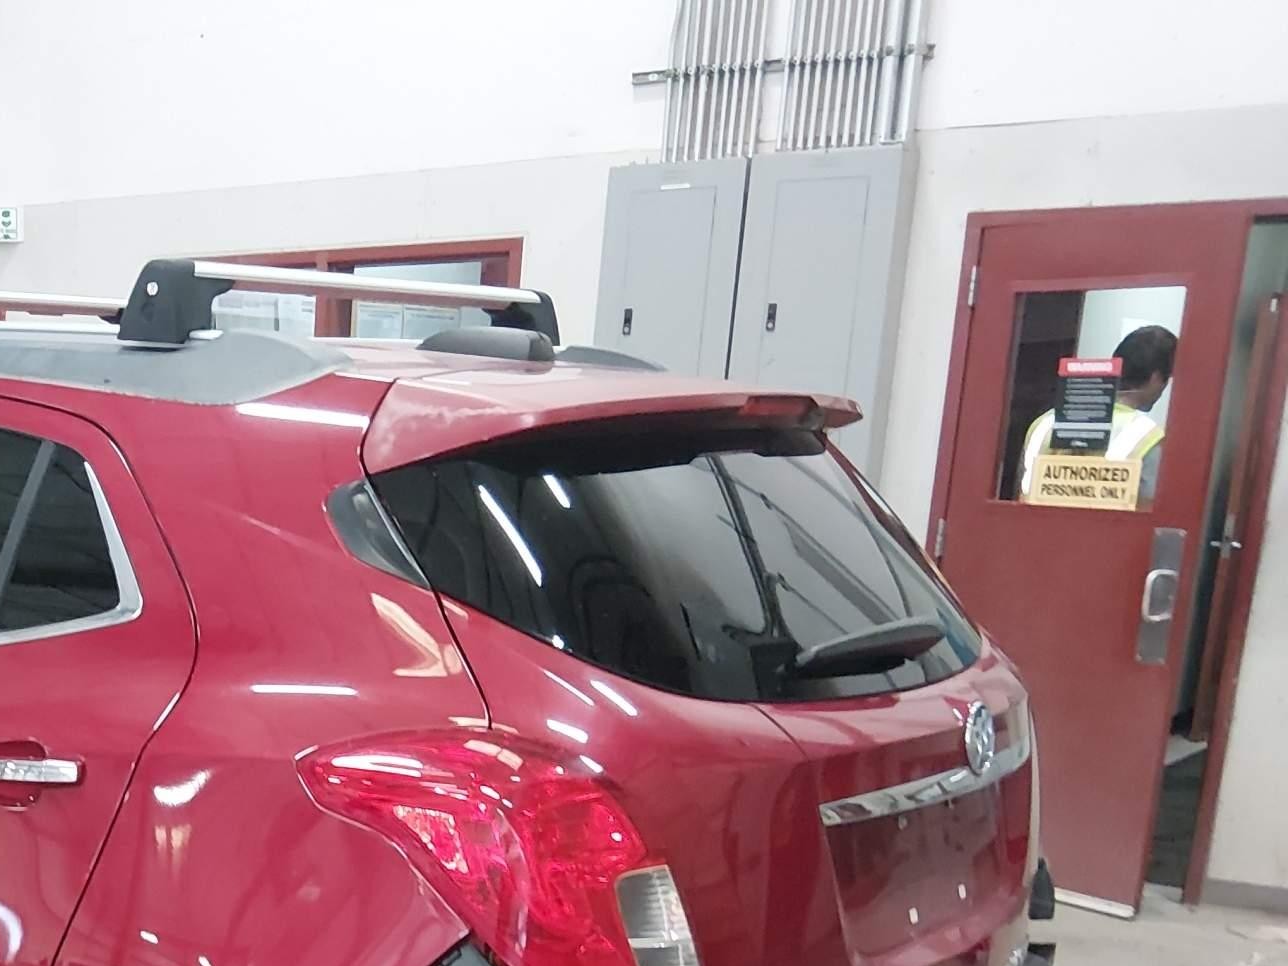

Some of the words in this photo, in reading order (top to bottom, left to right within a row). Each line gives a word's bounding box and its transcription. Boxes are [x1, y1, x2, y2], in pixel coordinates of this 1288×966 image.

[1043, 464, 1130, 482] AUTHORIZED
[1040, 483, 1097, 498] PERSONNEL
[1100, 485, 1128, 499] ONLY
